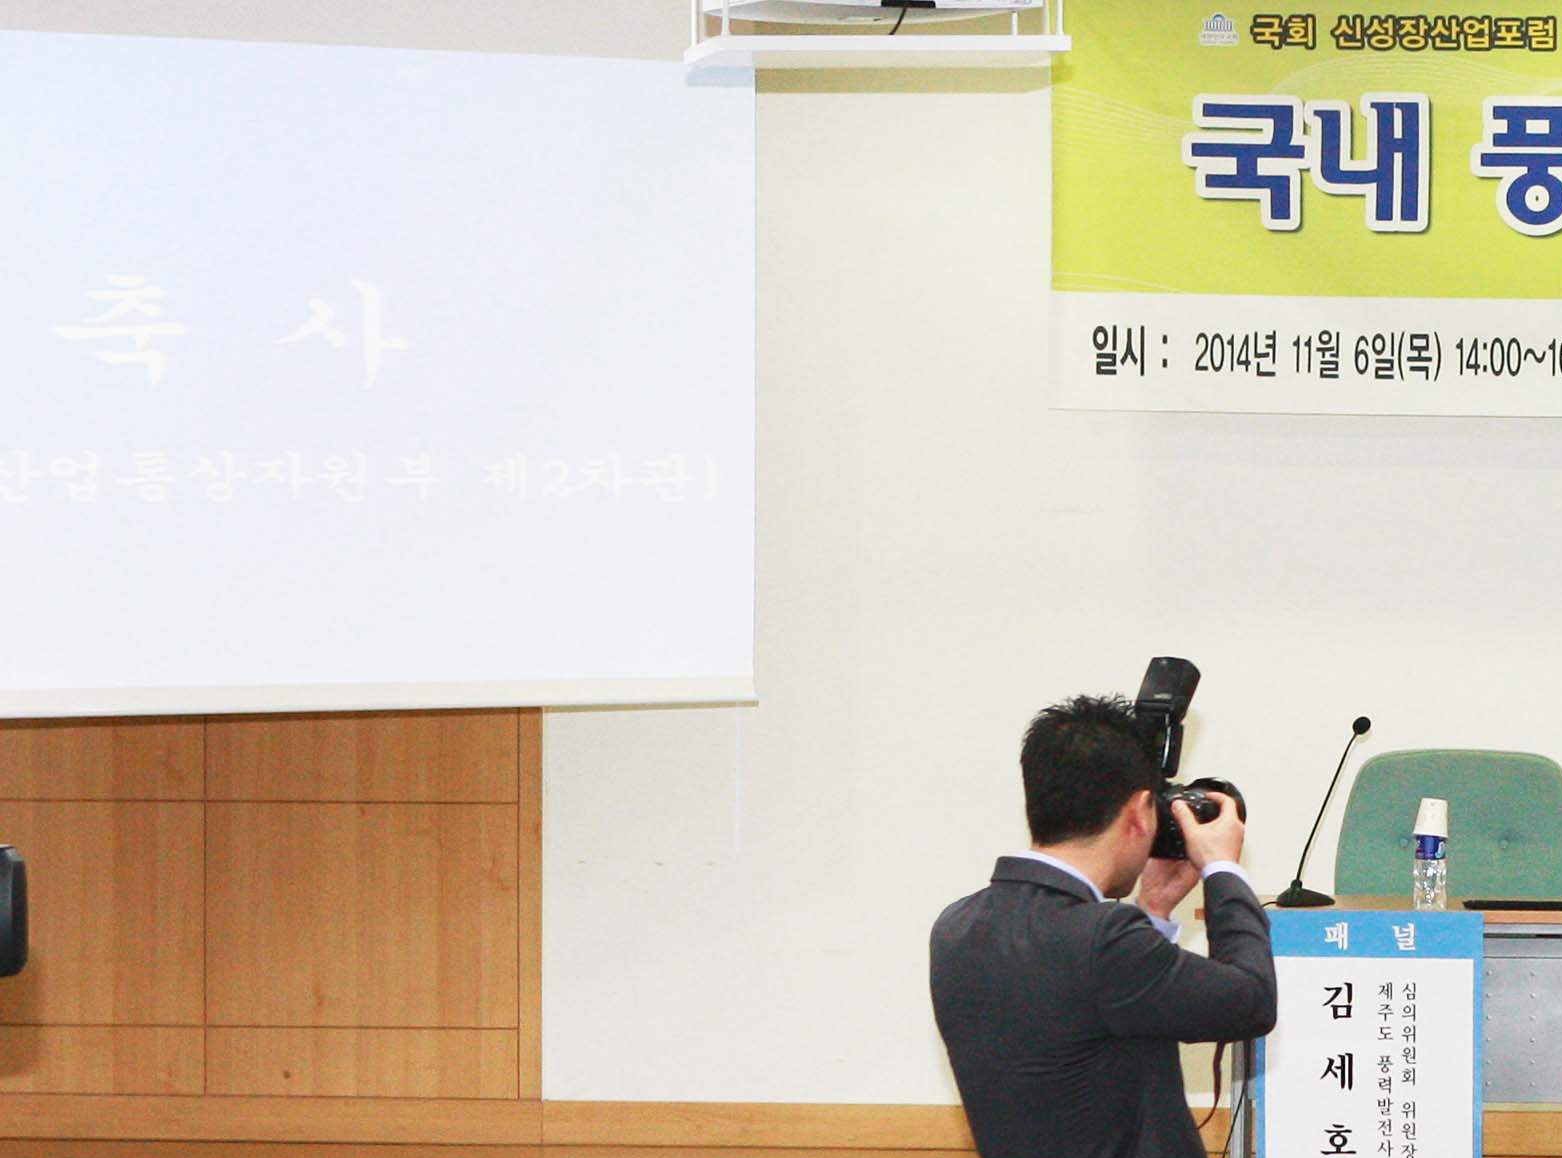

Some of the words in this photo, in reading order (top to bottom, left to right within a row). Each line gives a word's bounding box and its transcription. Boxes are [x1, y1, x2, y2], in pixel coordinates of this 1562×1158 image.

[1248, 12, 1318, 51] 국회
[1330, 13, 1558, 53] 신성장산업포럼
[1188, 97, 1424, 226] 국내
[1091, 324, 1146, 378] 일시
[1194, 329, 1278, 378] 2014년
[1291, 328, 1341, 380] 11월
[1353, 330, 1443, 382] 6일(목)
[480, 451, 722, 502] 제2차관)
[1377, 982, 1394, 1042] 제주도
[1401, 982, 1418, 1087] 심의위원회
[1319, 981, 1358, 1156] 김세호
